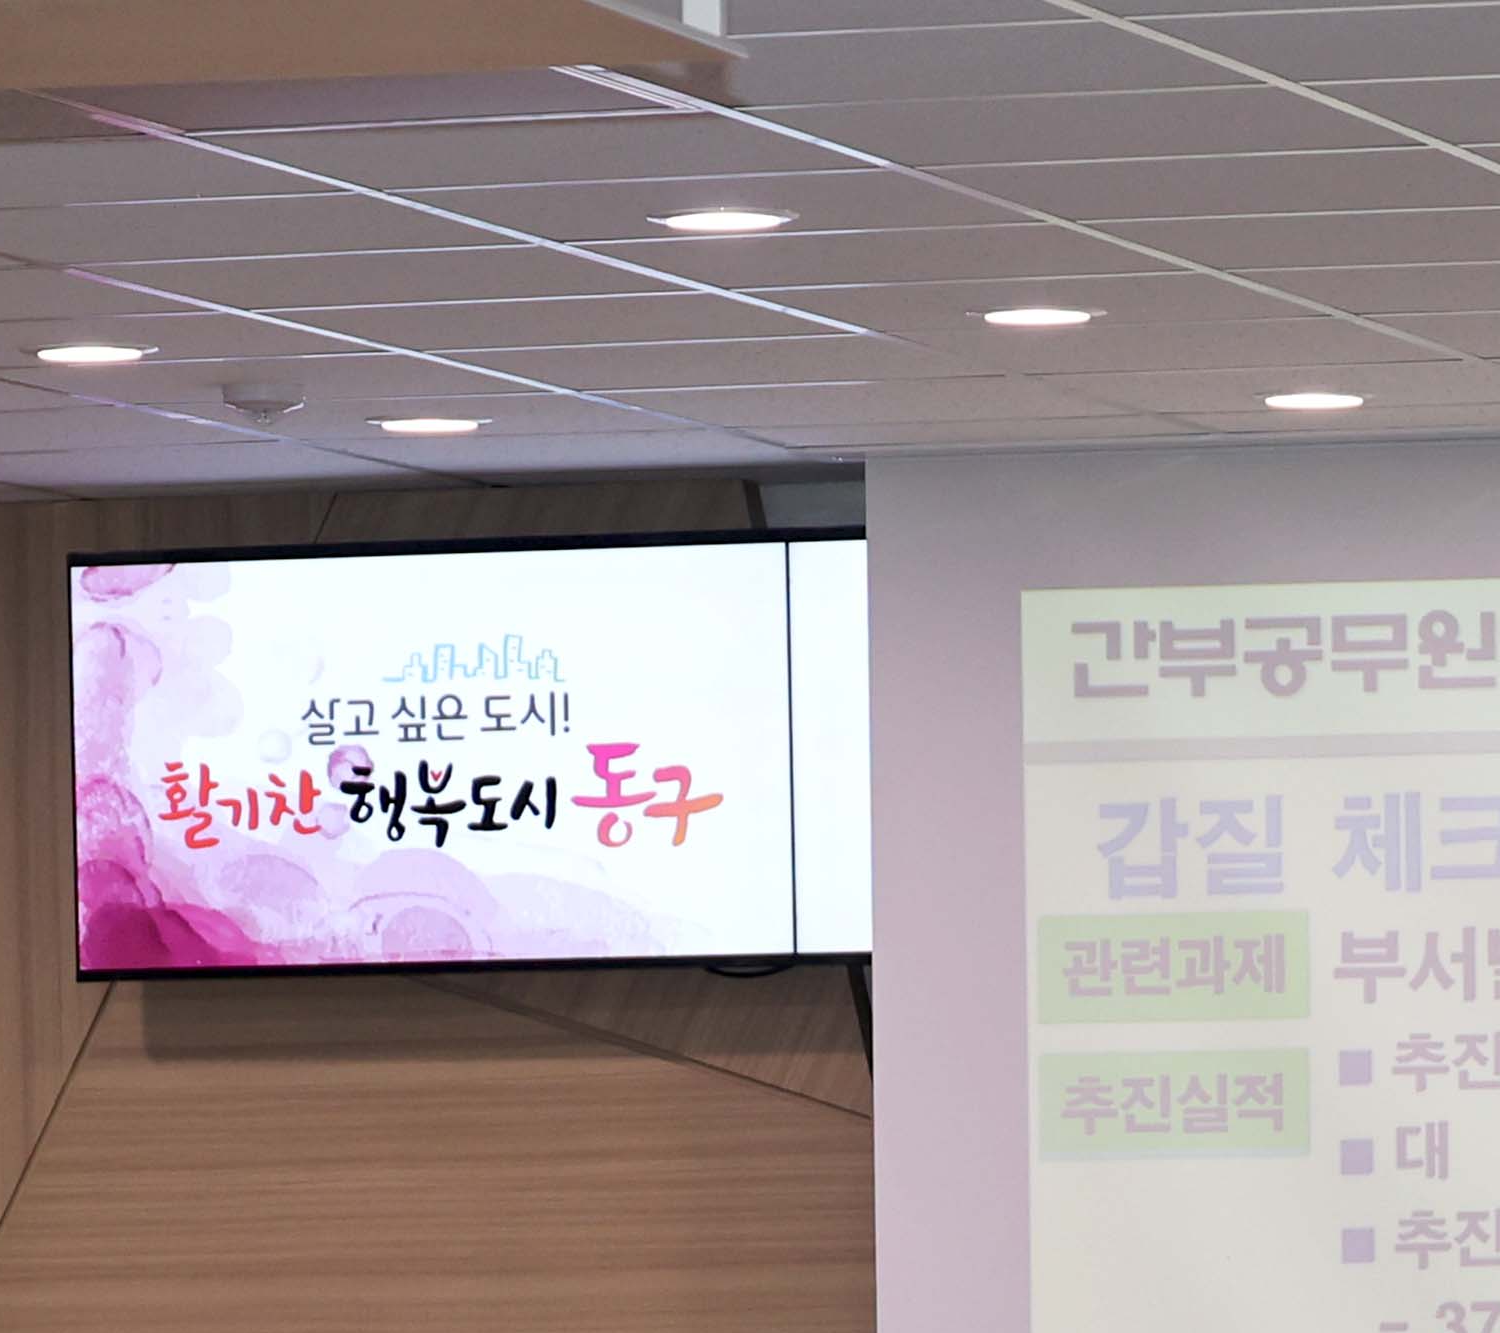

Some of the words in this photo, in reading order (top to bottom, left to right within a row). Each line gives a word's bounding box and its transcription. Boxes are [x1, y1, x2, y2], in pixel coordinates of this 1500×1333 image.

[1069, 609, 1497, 701] 간부공무원
[300, 697, 380, 747] 살고
[390, 693, 469, 744] 싶은
[480, 690, 571, 737] 도시!
[156, 759, 323, 852] 활기찬
[339, 757, 559, 850] 행복도시
[568, 740, 726, 849] 동구
[1095, 794, 1285, 901] 갑질
[1061, 933, 1287, 998] 관련과제
[1060, 1071, 1285, 1137] 추진실적
[1394, 1120, 1450, 1182] 대
